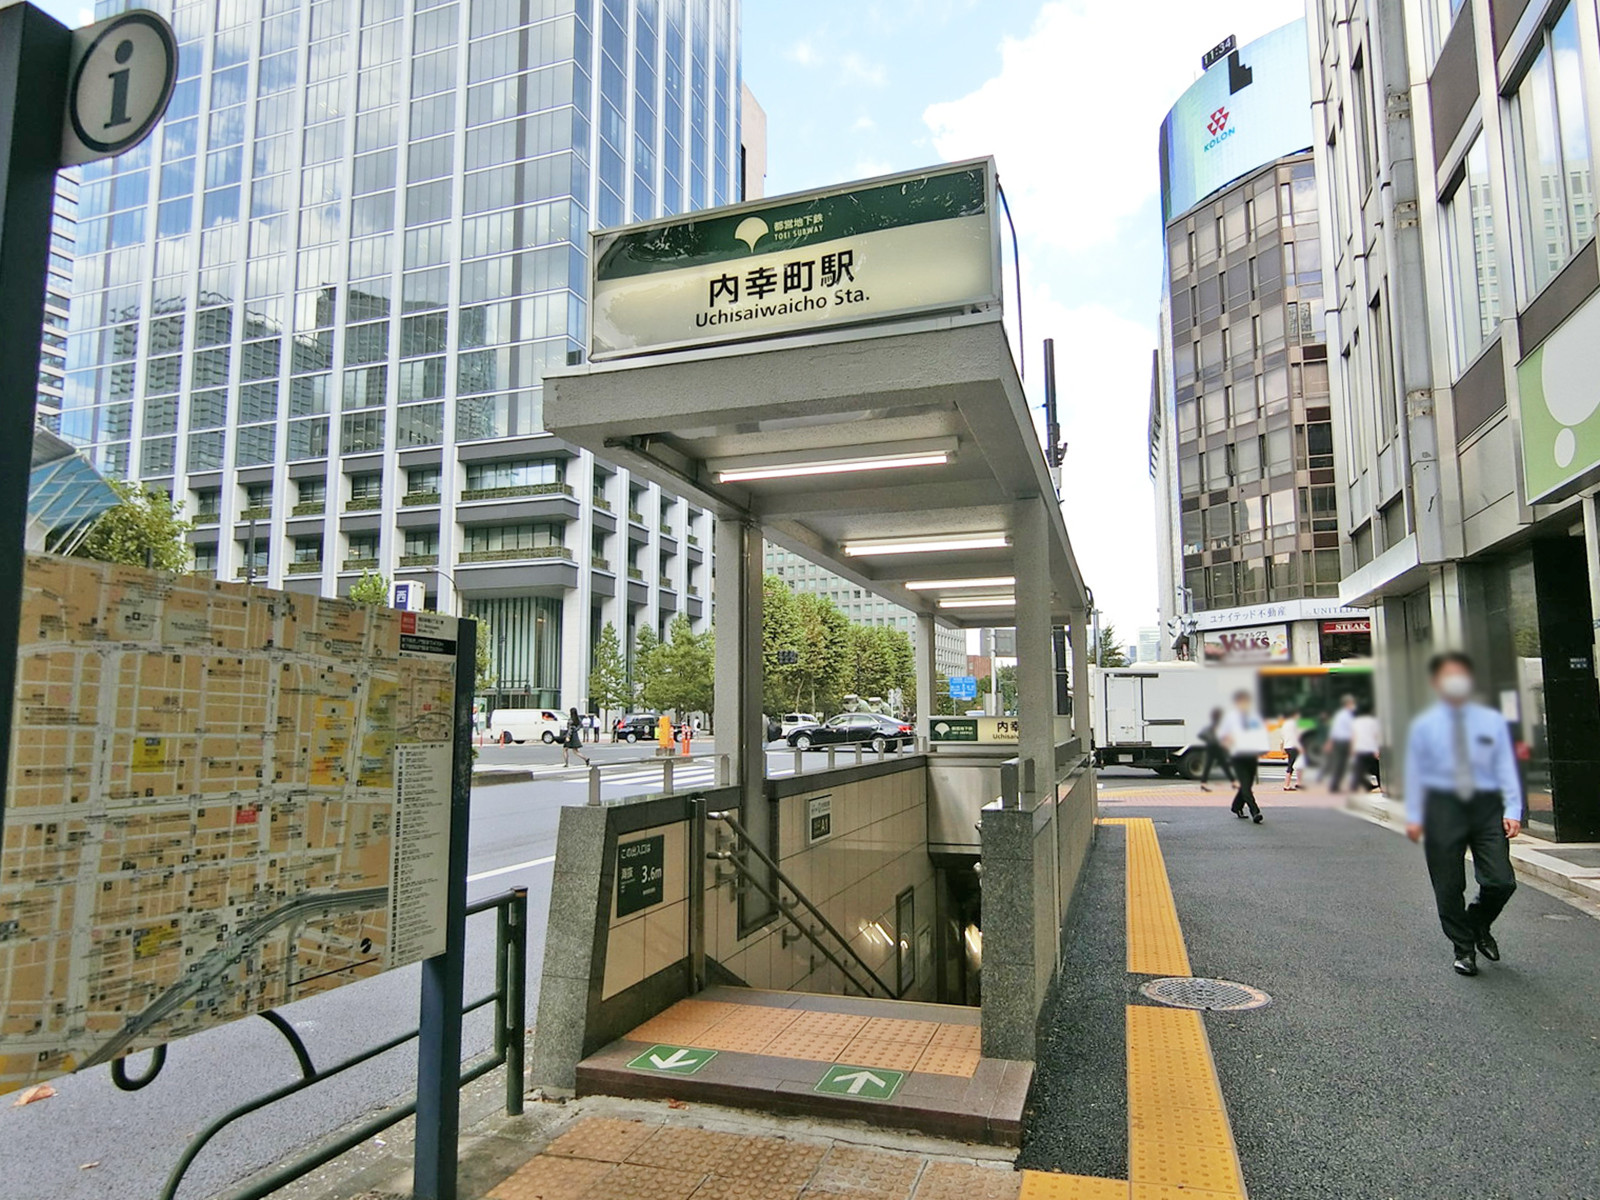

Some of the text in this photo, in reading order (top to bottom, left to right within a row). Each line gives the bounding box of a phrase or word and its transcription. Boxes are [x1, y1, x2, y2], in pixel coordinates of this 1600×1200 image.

[1203, 37, 1232, 64] 11:34
[1204, 127, 1235, 152] KOLON
[774, 213, 824, 231] 都営地下鉄
[774, 224, 824, 241] TOEI SUBWAY
[709, 248, 855, 308] 内幸町駅
[695, 285, 871, 328] Uchisaiwaicho Sta.
[1210, 606, 1286, 624] ユナイテッド不動産
[1313, 606, 1353, 615] UNITED
[1335, 622, 1366, 630] STEAK
[621, 844, 651, 859] この出入口は
[641, 864, 662, 884] 3.6m
